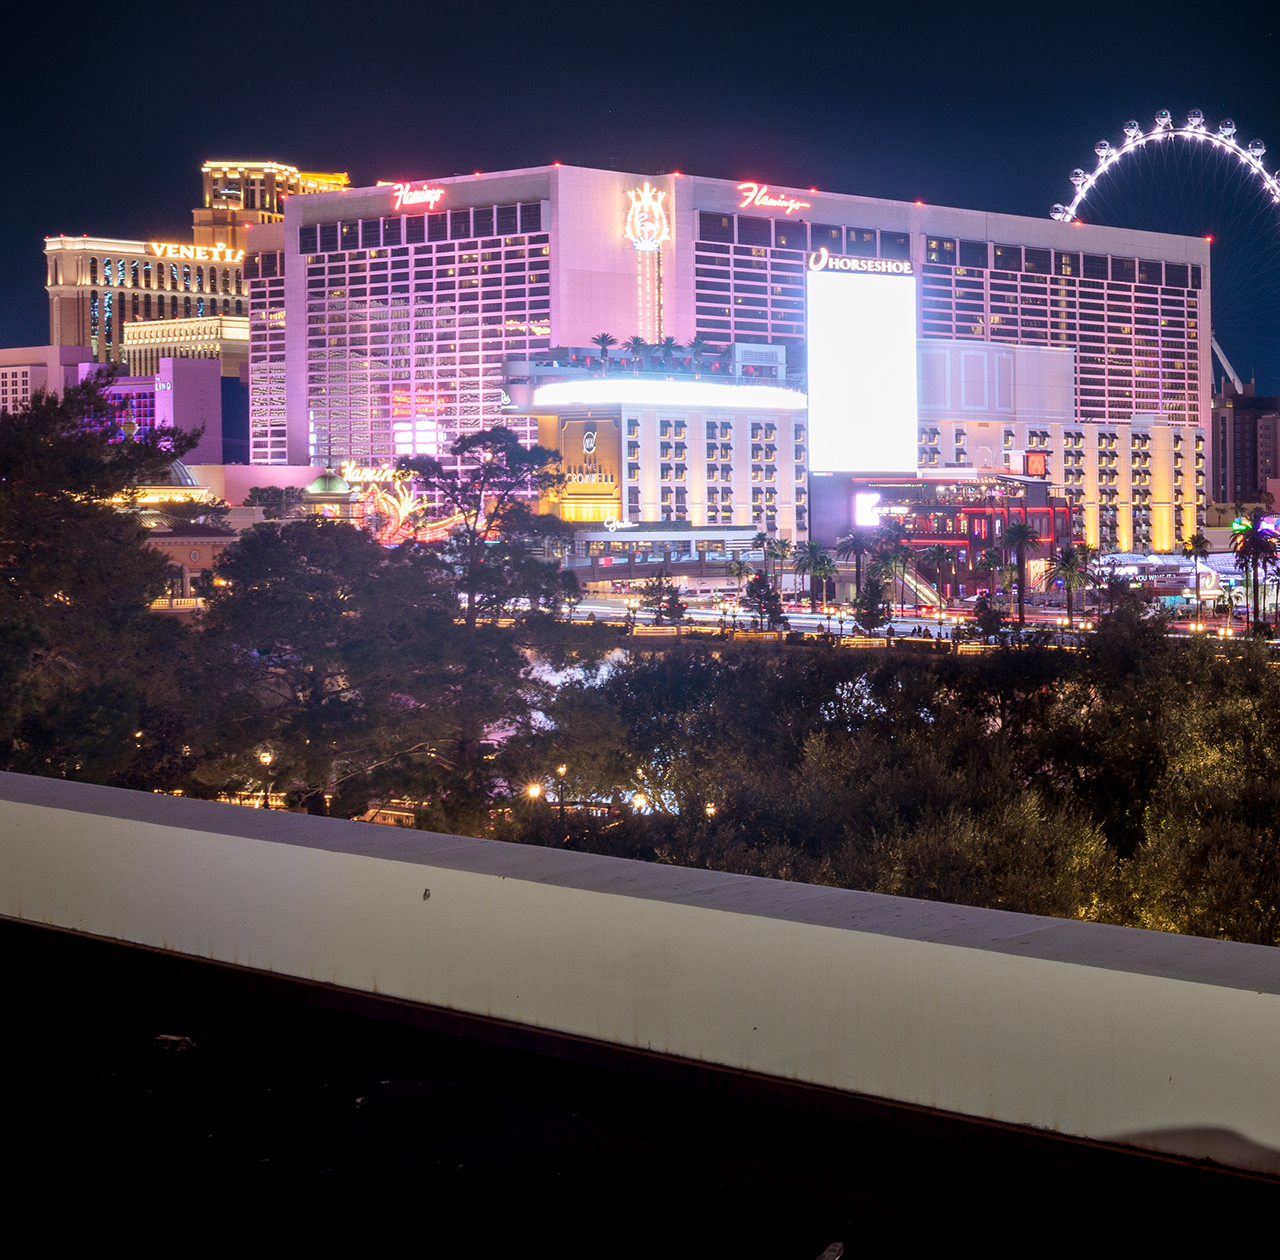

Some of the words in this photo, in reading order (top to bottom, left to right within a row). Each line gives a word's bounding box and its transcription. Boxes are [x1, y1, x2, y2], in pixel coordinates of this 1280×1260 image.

[392, 182, 445, 210] Flamingo
[736, 181, 811, 215] Flamingo
[828, 258, 914, 274] HORSESHOE
[566, 472, 614, 485] CROMWELL
